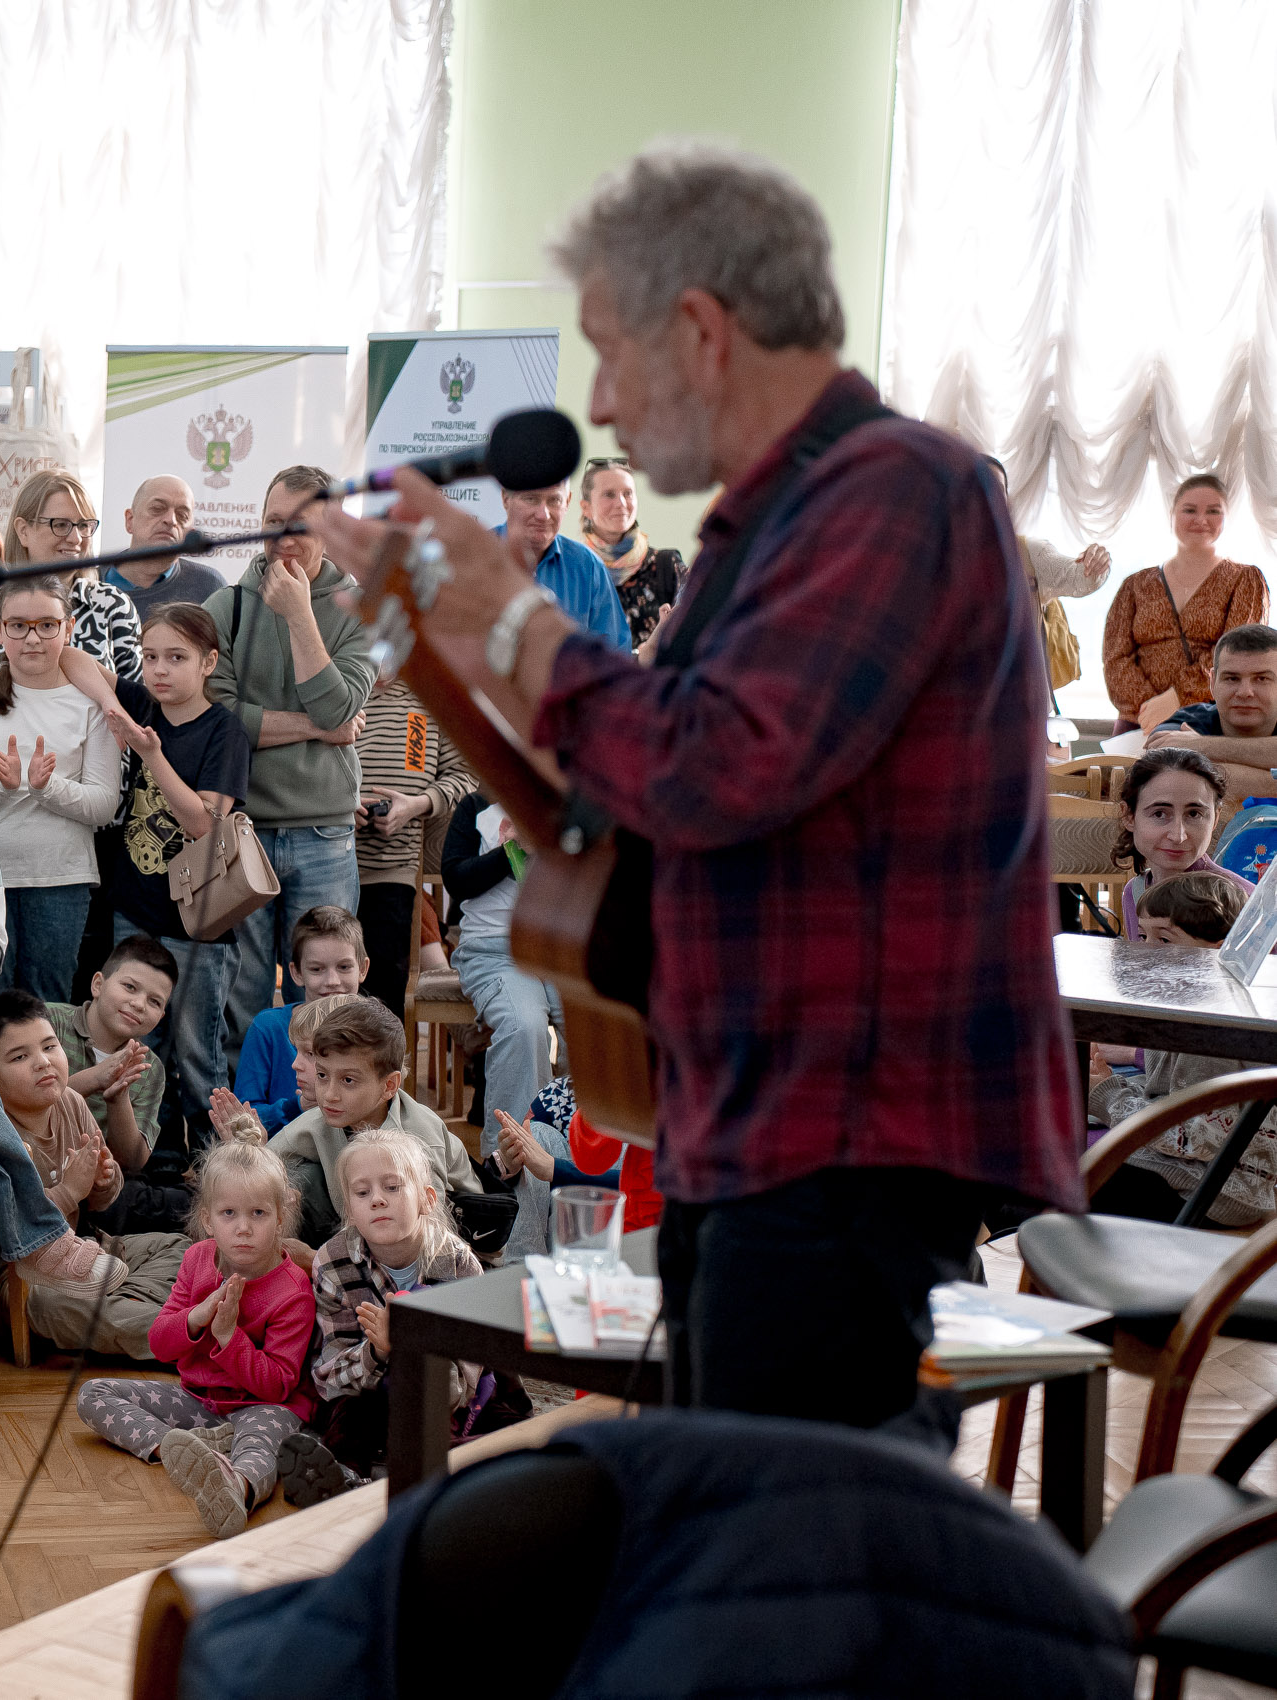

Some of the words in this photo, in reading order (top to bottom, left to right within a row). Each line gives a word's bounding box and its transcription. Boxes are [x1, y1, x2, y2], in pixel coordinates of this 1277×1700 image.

[431, 420, 477, 430] УПРАВЛЕНИЕ
[379, 444, 389, 453] ПО
[390, 443, 427, 454] ТВЕРСКОЙ
[194, 502, 256, 514] РАВЛЕНИЕ
